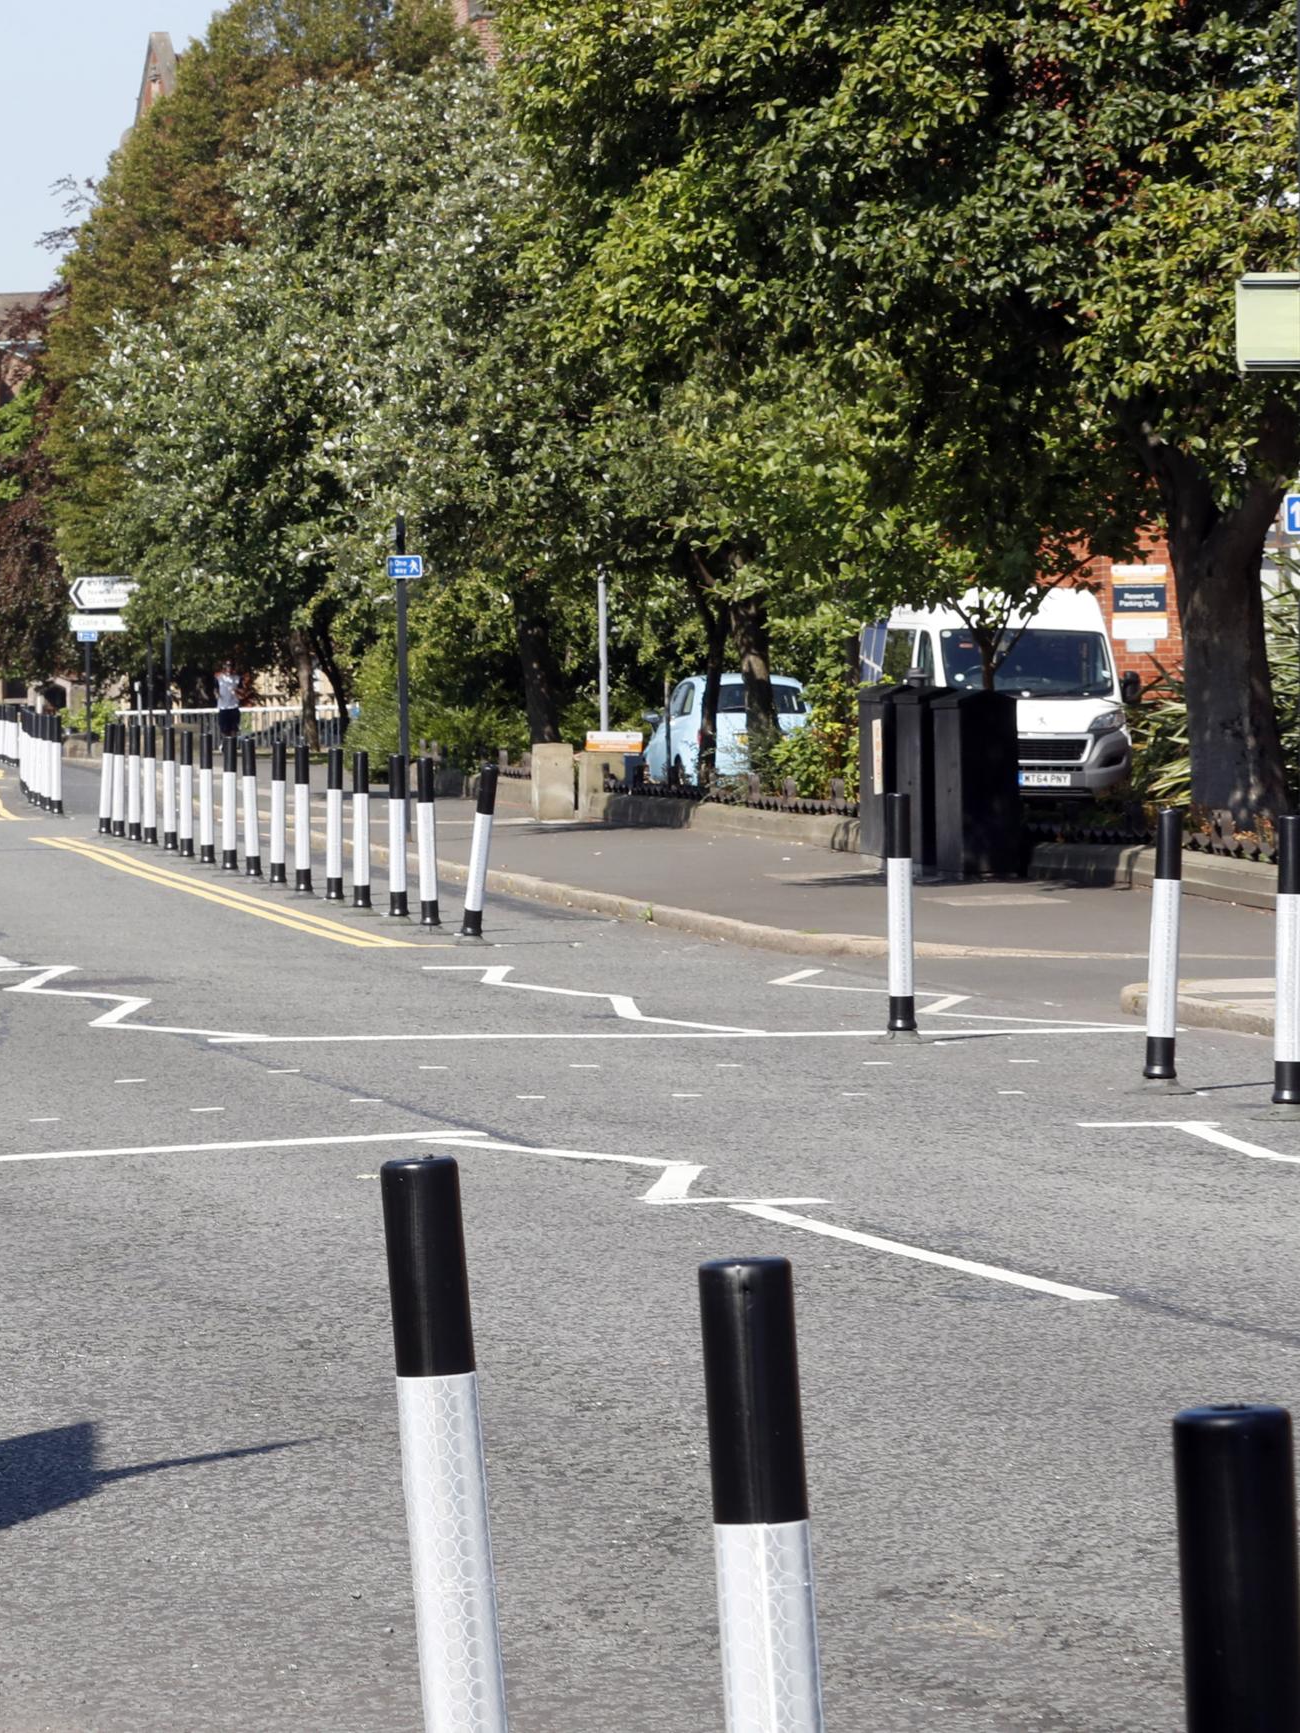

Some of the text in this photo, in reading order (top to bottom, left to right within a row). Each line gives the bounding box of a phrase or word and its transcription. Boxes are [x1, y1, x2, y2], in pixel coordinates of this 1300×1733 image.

[1119, 600, 1160, 608] Parking Only
[1051, 774, 1069, 784] PNY
